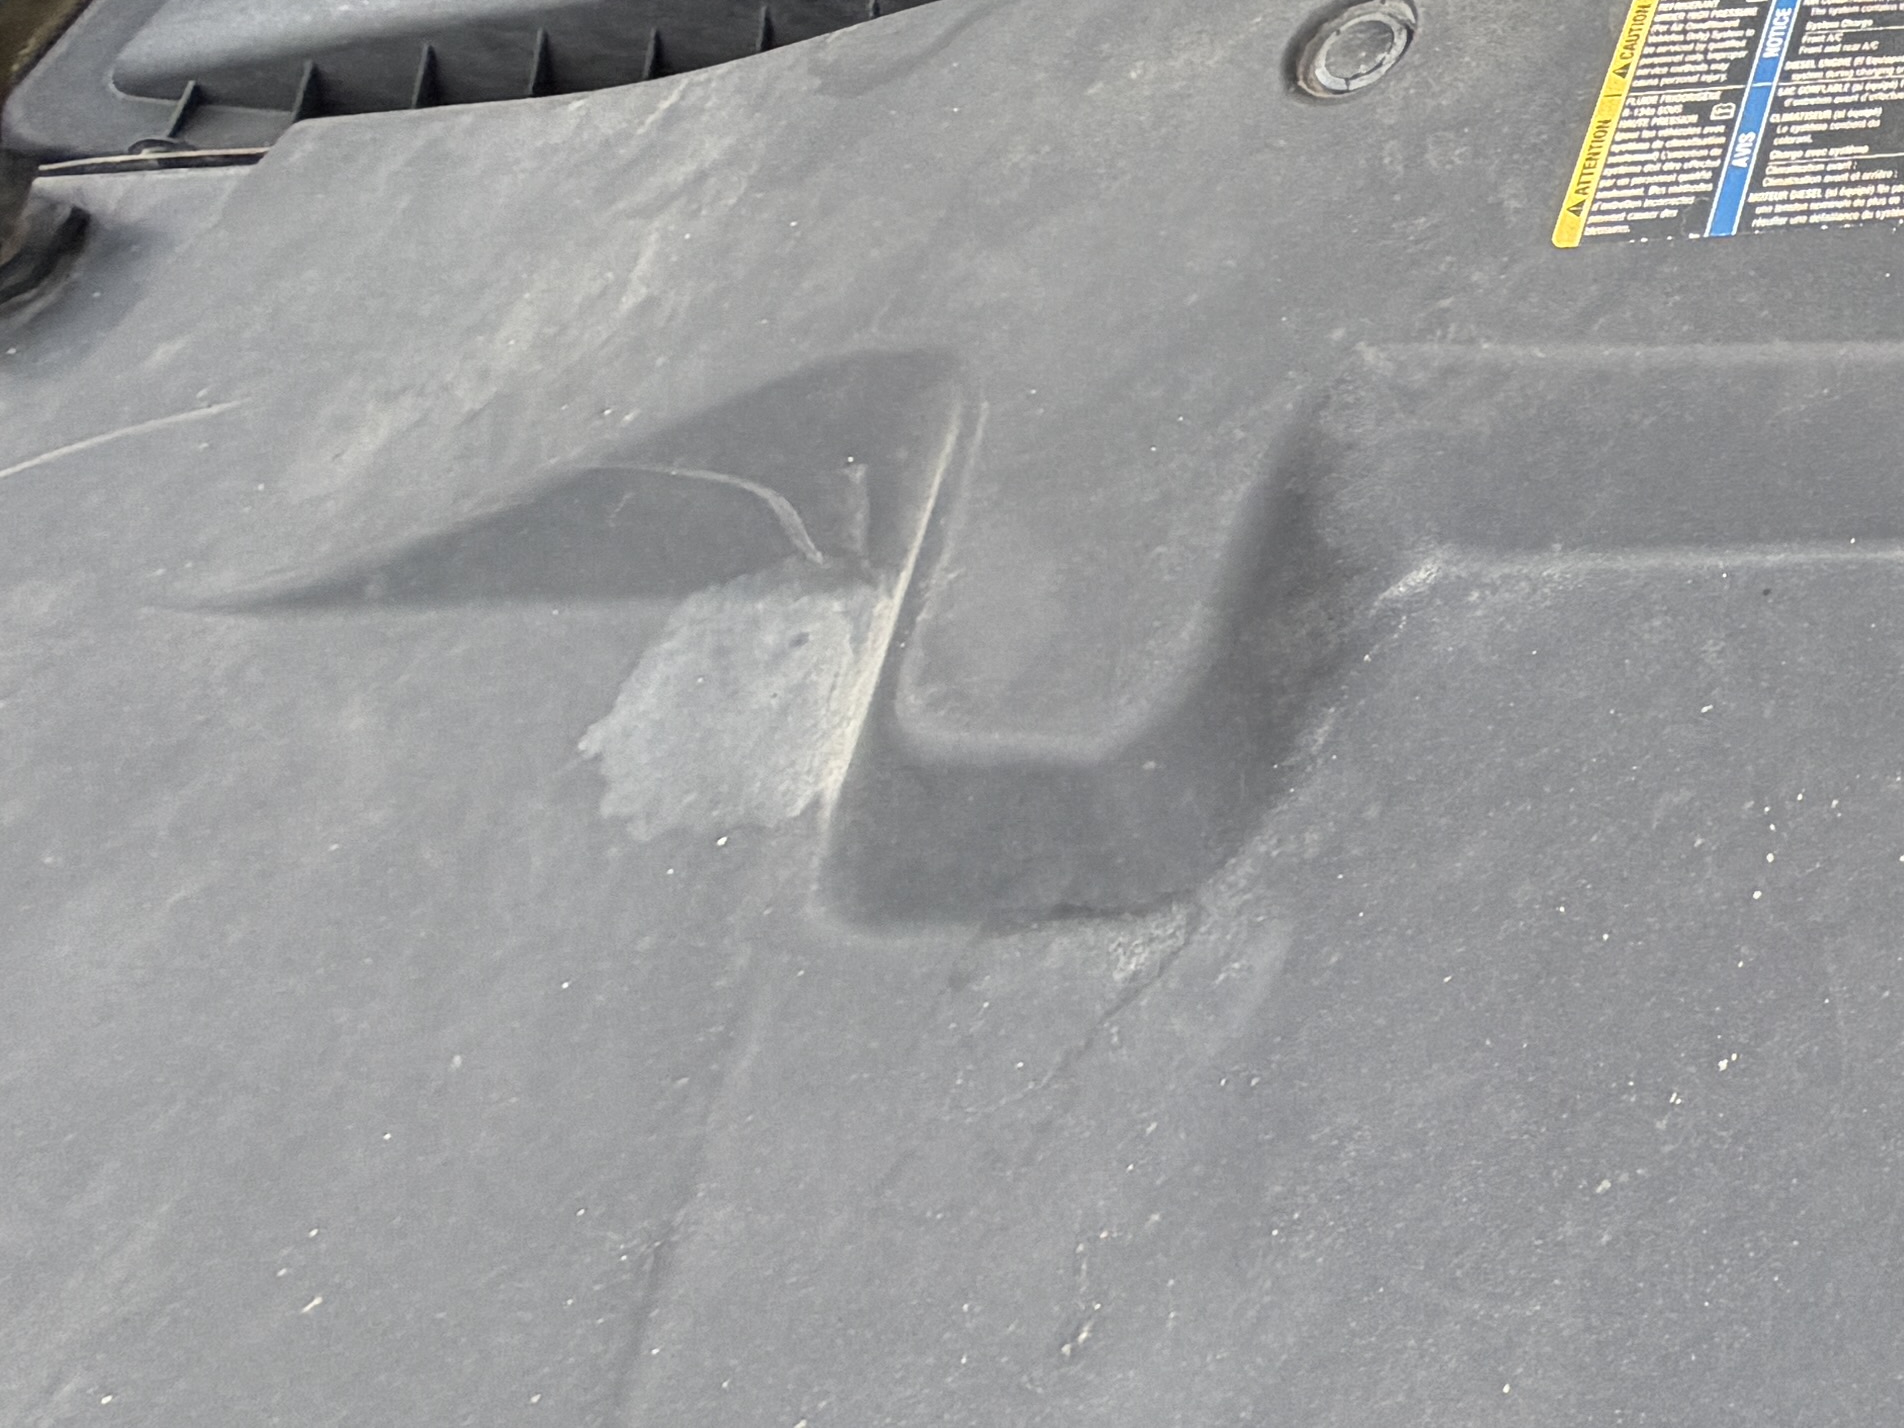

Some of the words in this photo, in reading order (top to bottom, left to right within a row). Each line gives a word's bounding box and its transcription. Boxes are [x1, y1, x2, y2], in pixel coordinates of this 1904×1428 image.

[1620, 2, 1651, 61] CAUTION
[1763, 7, 1793, 59] NOTICE
[1575, 118, 1613, 196] ATTENTION
[1731, 132, 1758, 170] AVIS
